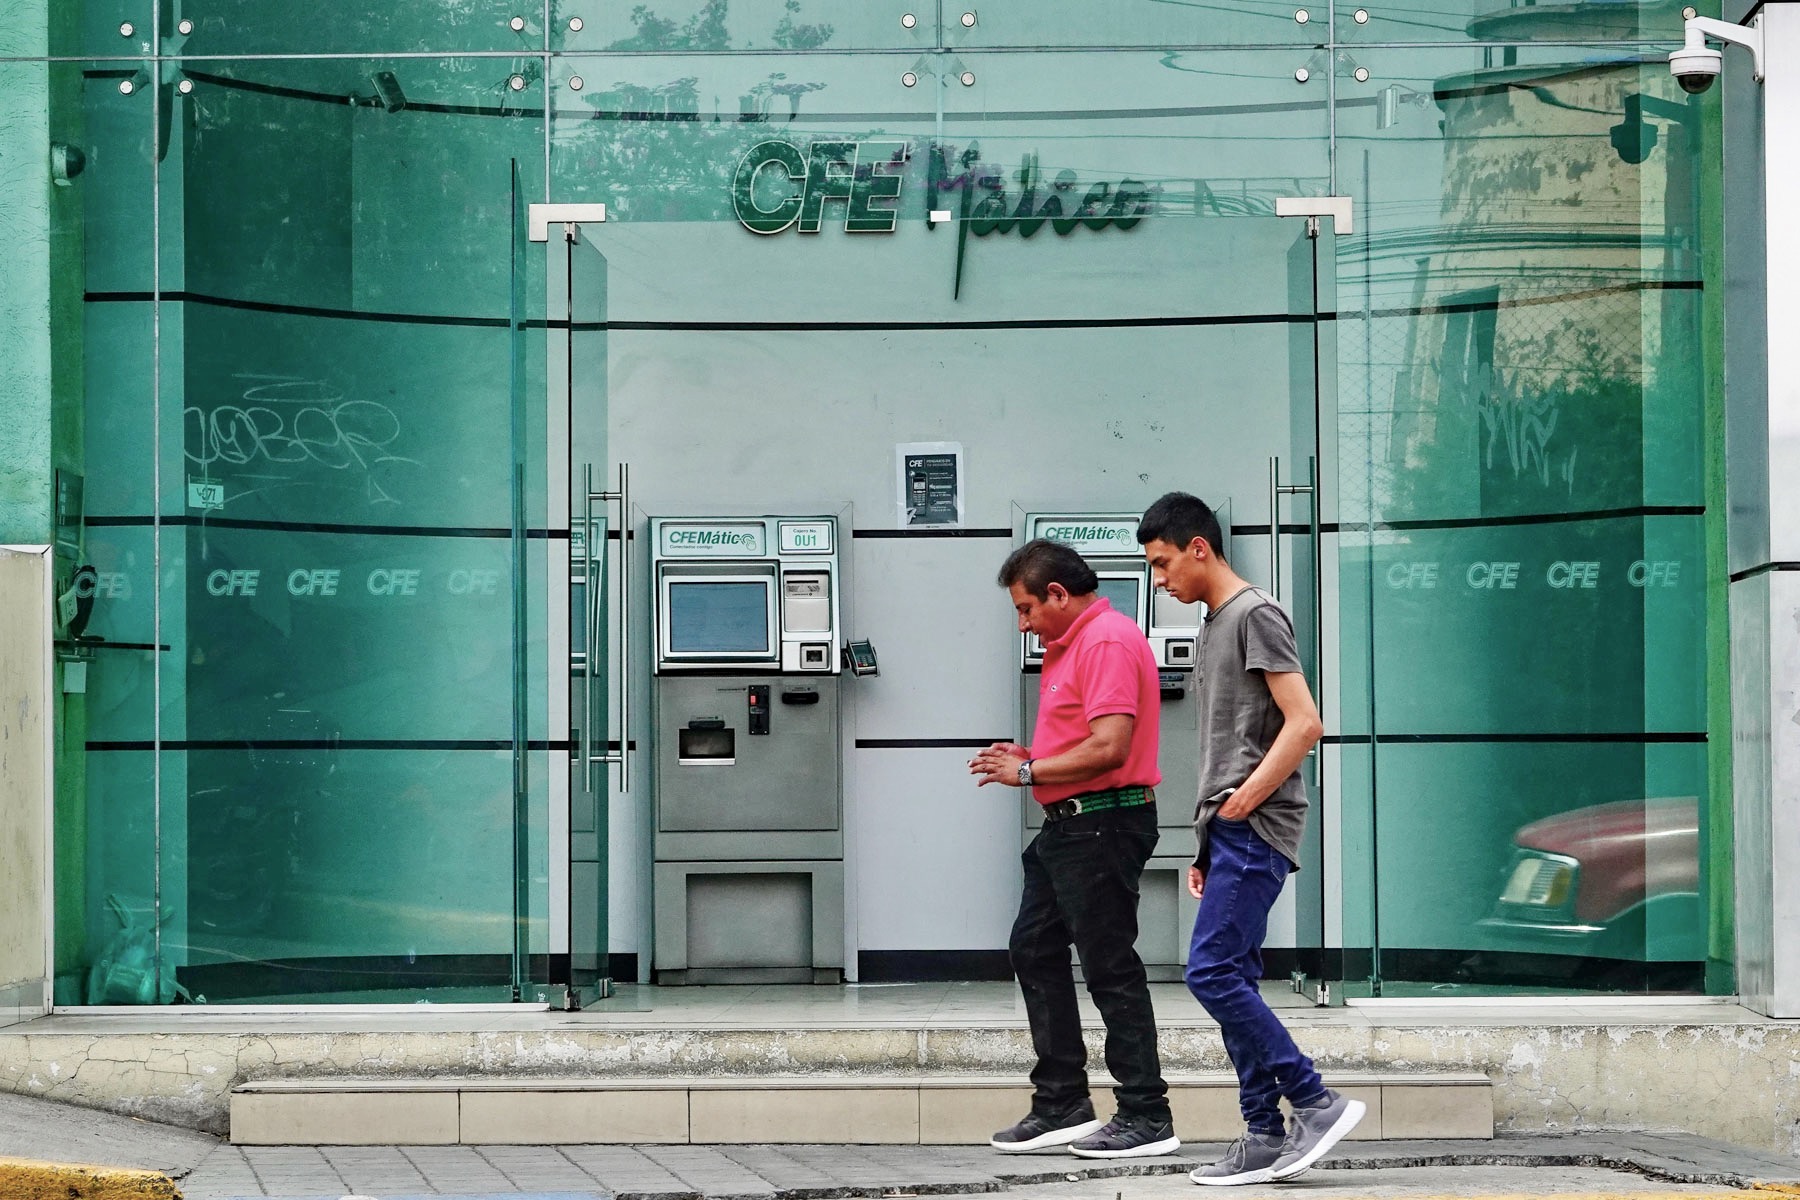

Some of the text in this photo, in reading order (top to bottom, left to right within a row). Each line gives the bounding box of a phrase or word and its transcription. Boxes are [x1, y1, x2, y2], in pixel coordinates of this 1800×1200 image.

[733, 140, 907, 235] CFE
[74, 568, 499, 600] CFE CFE CFE CFE CFE
[1387, 560, 1681, 589] CFE CFE CFE CFE
